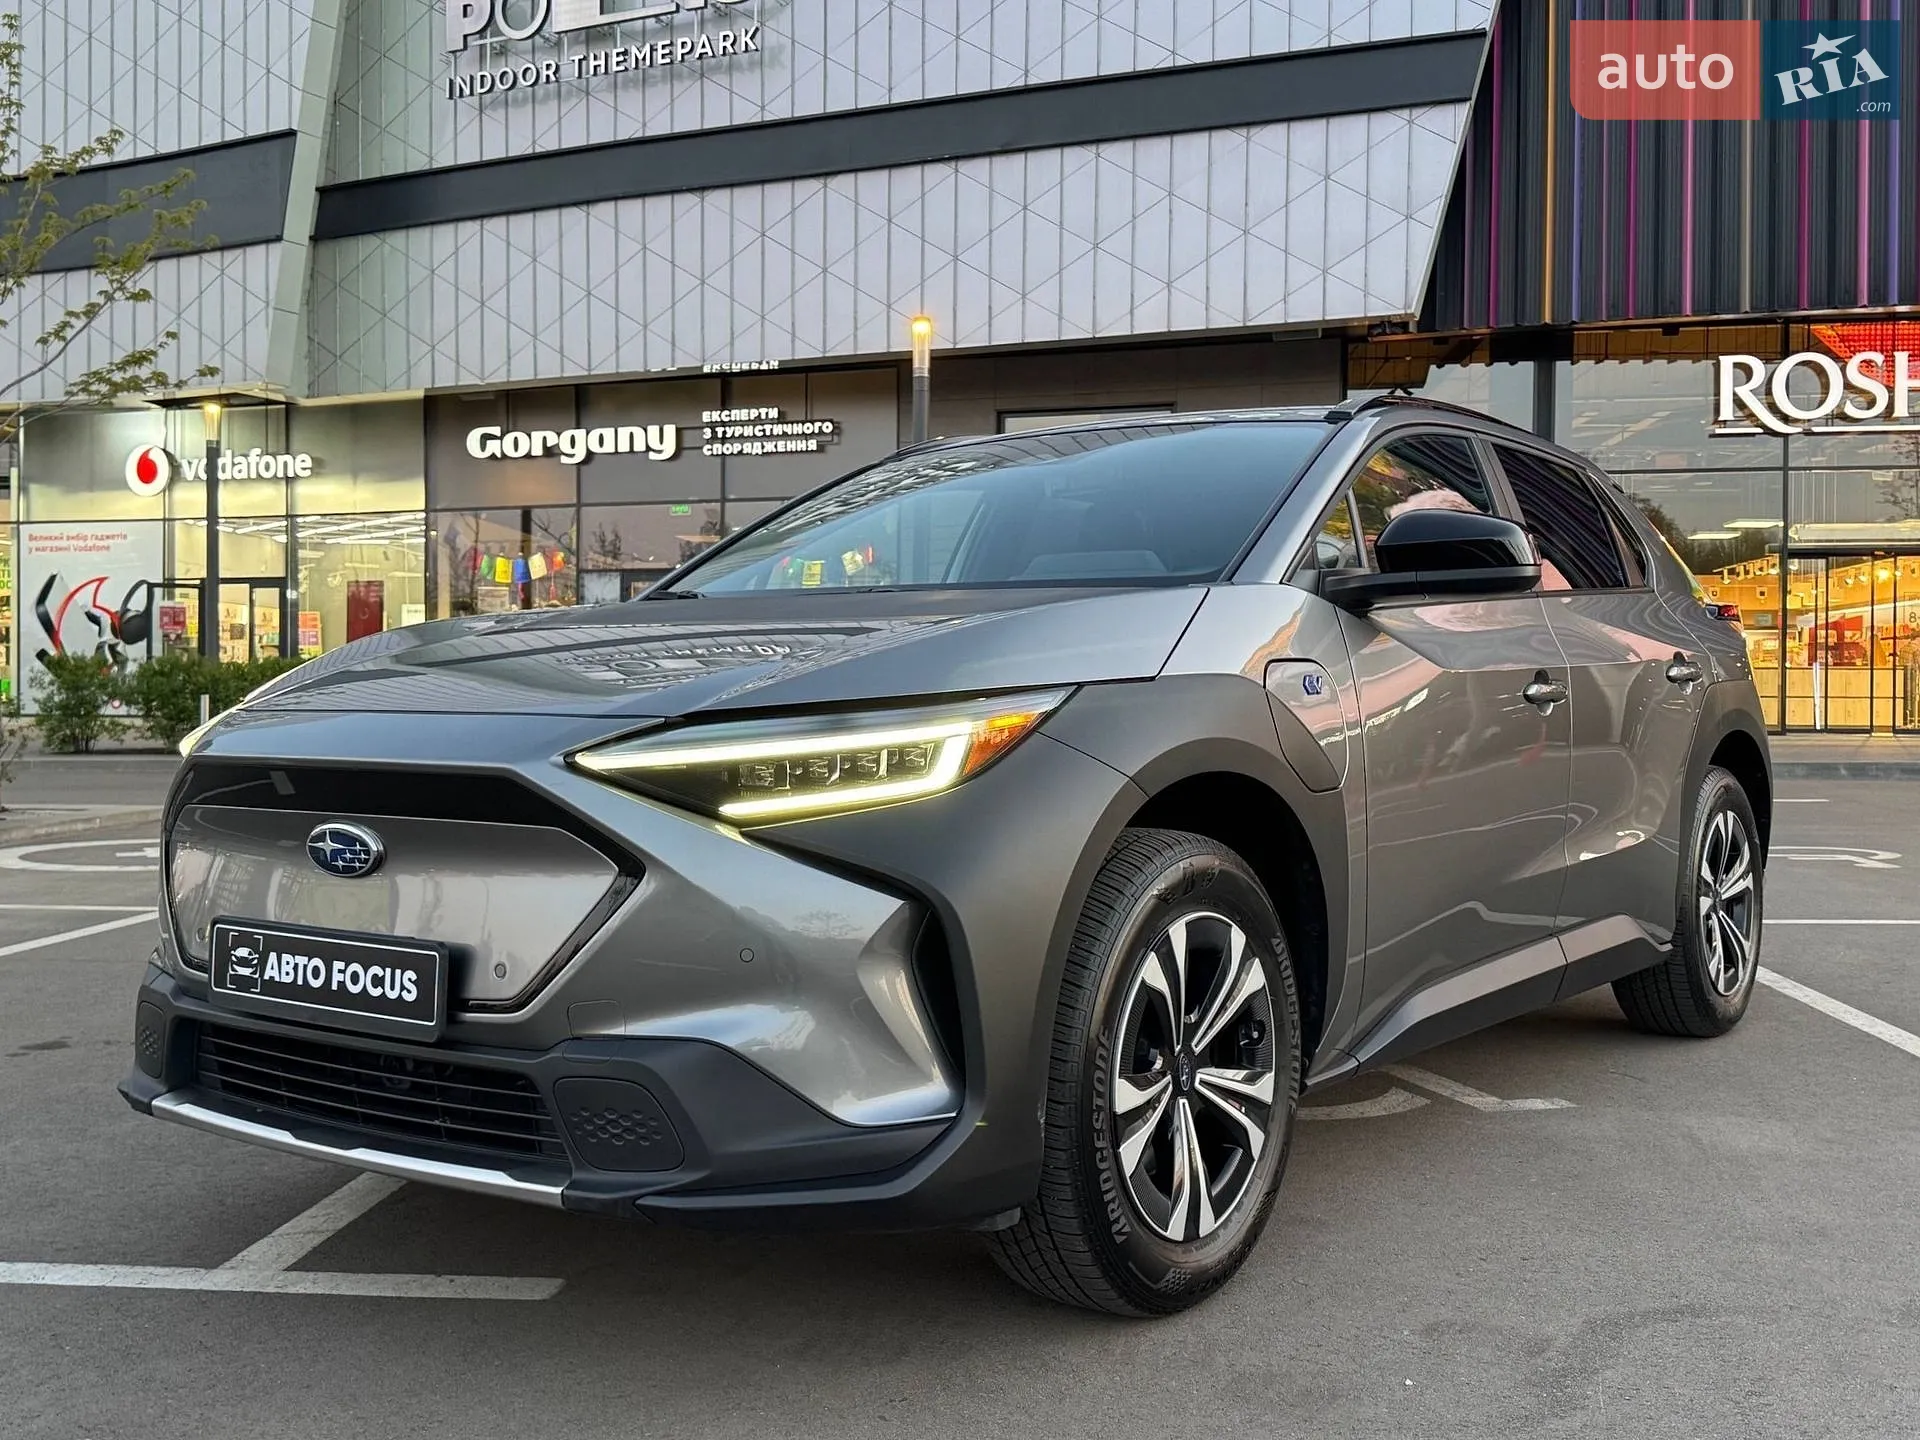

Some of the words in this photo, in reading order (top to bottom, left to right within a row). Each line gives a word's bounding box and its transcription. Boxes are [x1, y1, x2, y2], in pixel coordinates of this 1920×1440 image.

[446, 62, 559, 98] INDOOR
[571, 26, 760, 79] THEMEPARK
[702, 407, 779, 422] ЕКСПЕРТИ
[715, 421, 834, 438] ТУРИСТИЧНОГО
[466, 424, 677, 464] Gorgany
[703, 439, 818, 455] СПОРЯДЖЕННЯ
[28, 532, 64, 542] Великий
[90, 530, 128, 541] гаджетів
[35, 545, 71, 553] магазині
[73, 543, 110, 552] Vodafone
[264, 951, 326, 988] АВТО
[331, 960, 418, 1002] FOCUS
[1091, 1025, 1129, 1245] BRIDGESTONE
